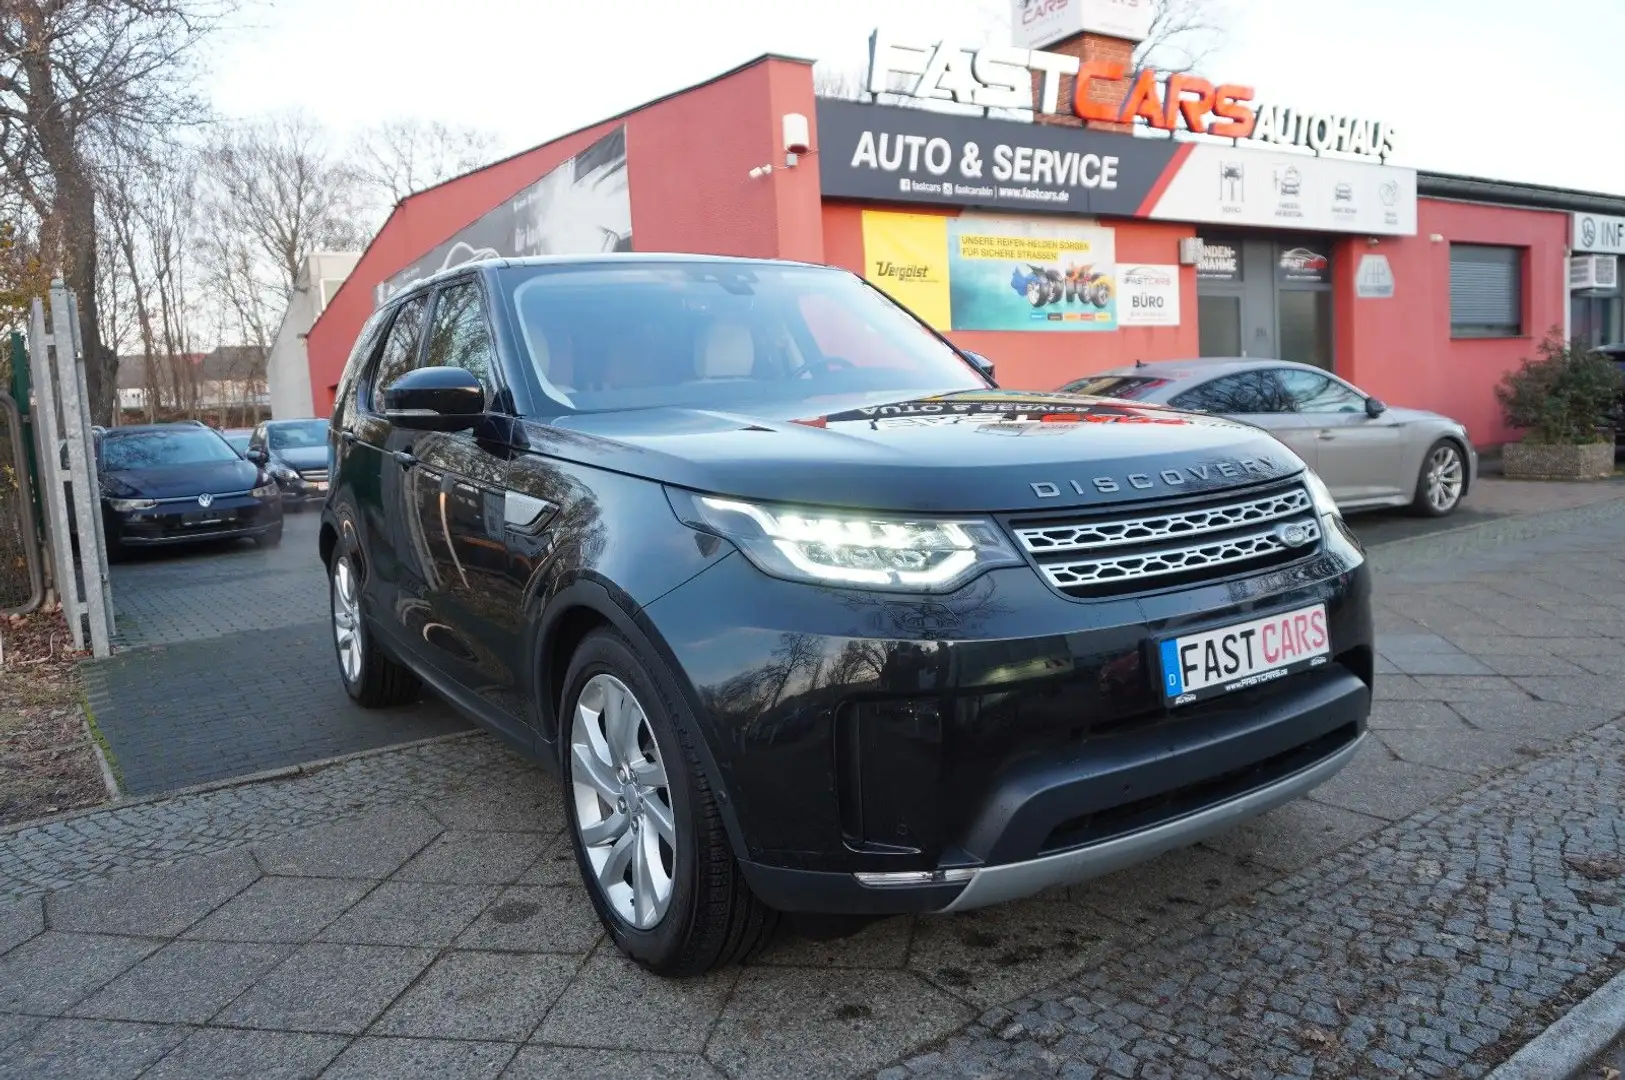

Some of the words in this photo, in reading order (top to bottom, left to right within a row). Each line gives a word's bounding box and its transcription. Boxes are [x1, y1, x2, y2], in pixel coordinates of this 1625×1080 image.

[1252, 104, 1397, 158] AUTOHAUS
[851, 131, 951, 175] AUTO
[960, 142, 983, 178] &
[991, 144, 1119, 190] SERVICE
[1000, 186, 1070, 201] www.fastcars.de
[962, 236, 995, 246] UNSERE
[1059, 241, 1089, 251] SORGEN
[980, 247, 1015, 259] SICHERE
[876, 261, 929, 281] Vergölst
[1132, 291, 1164, 308] BÜRO
[1029, 456, 1278, 498] DISCOVERY
[1168, 673, 1177, 687] D
